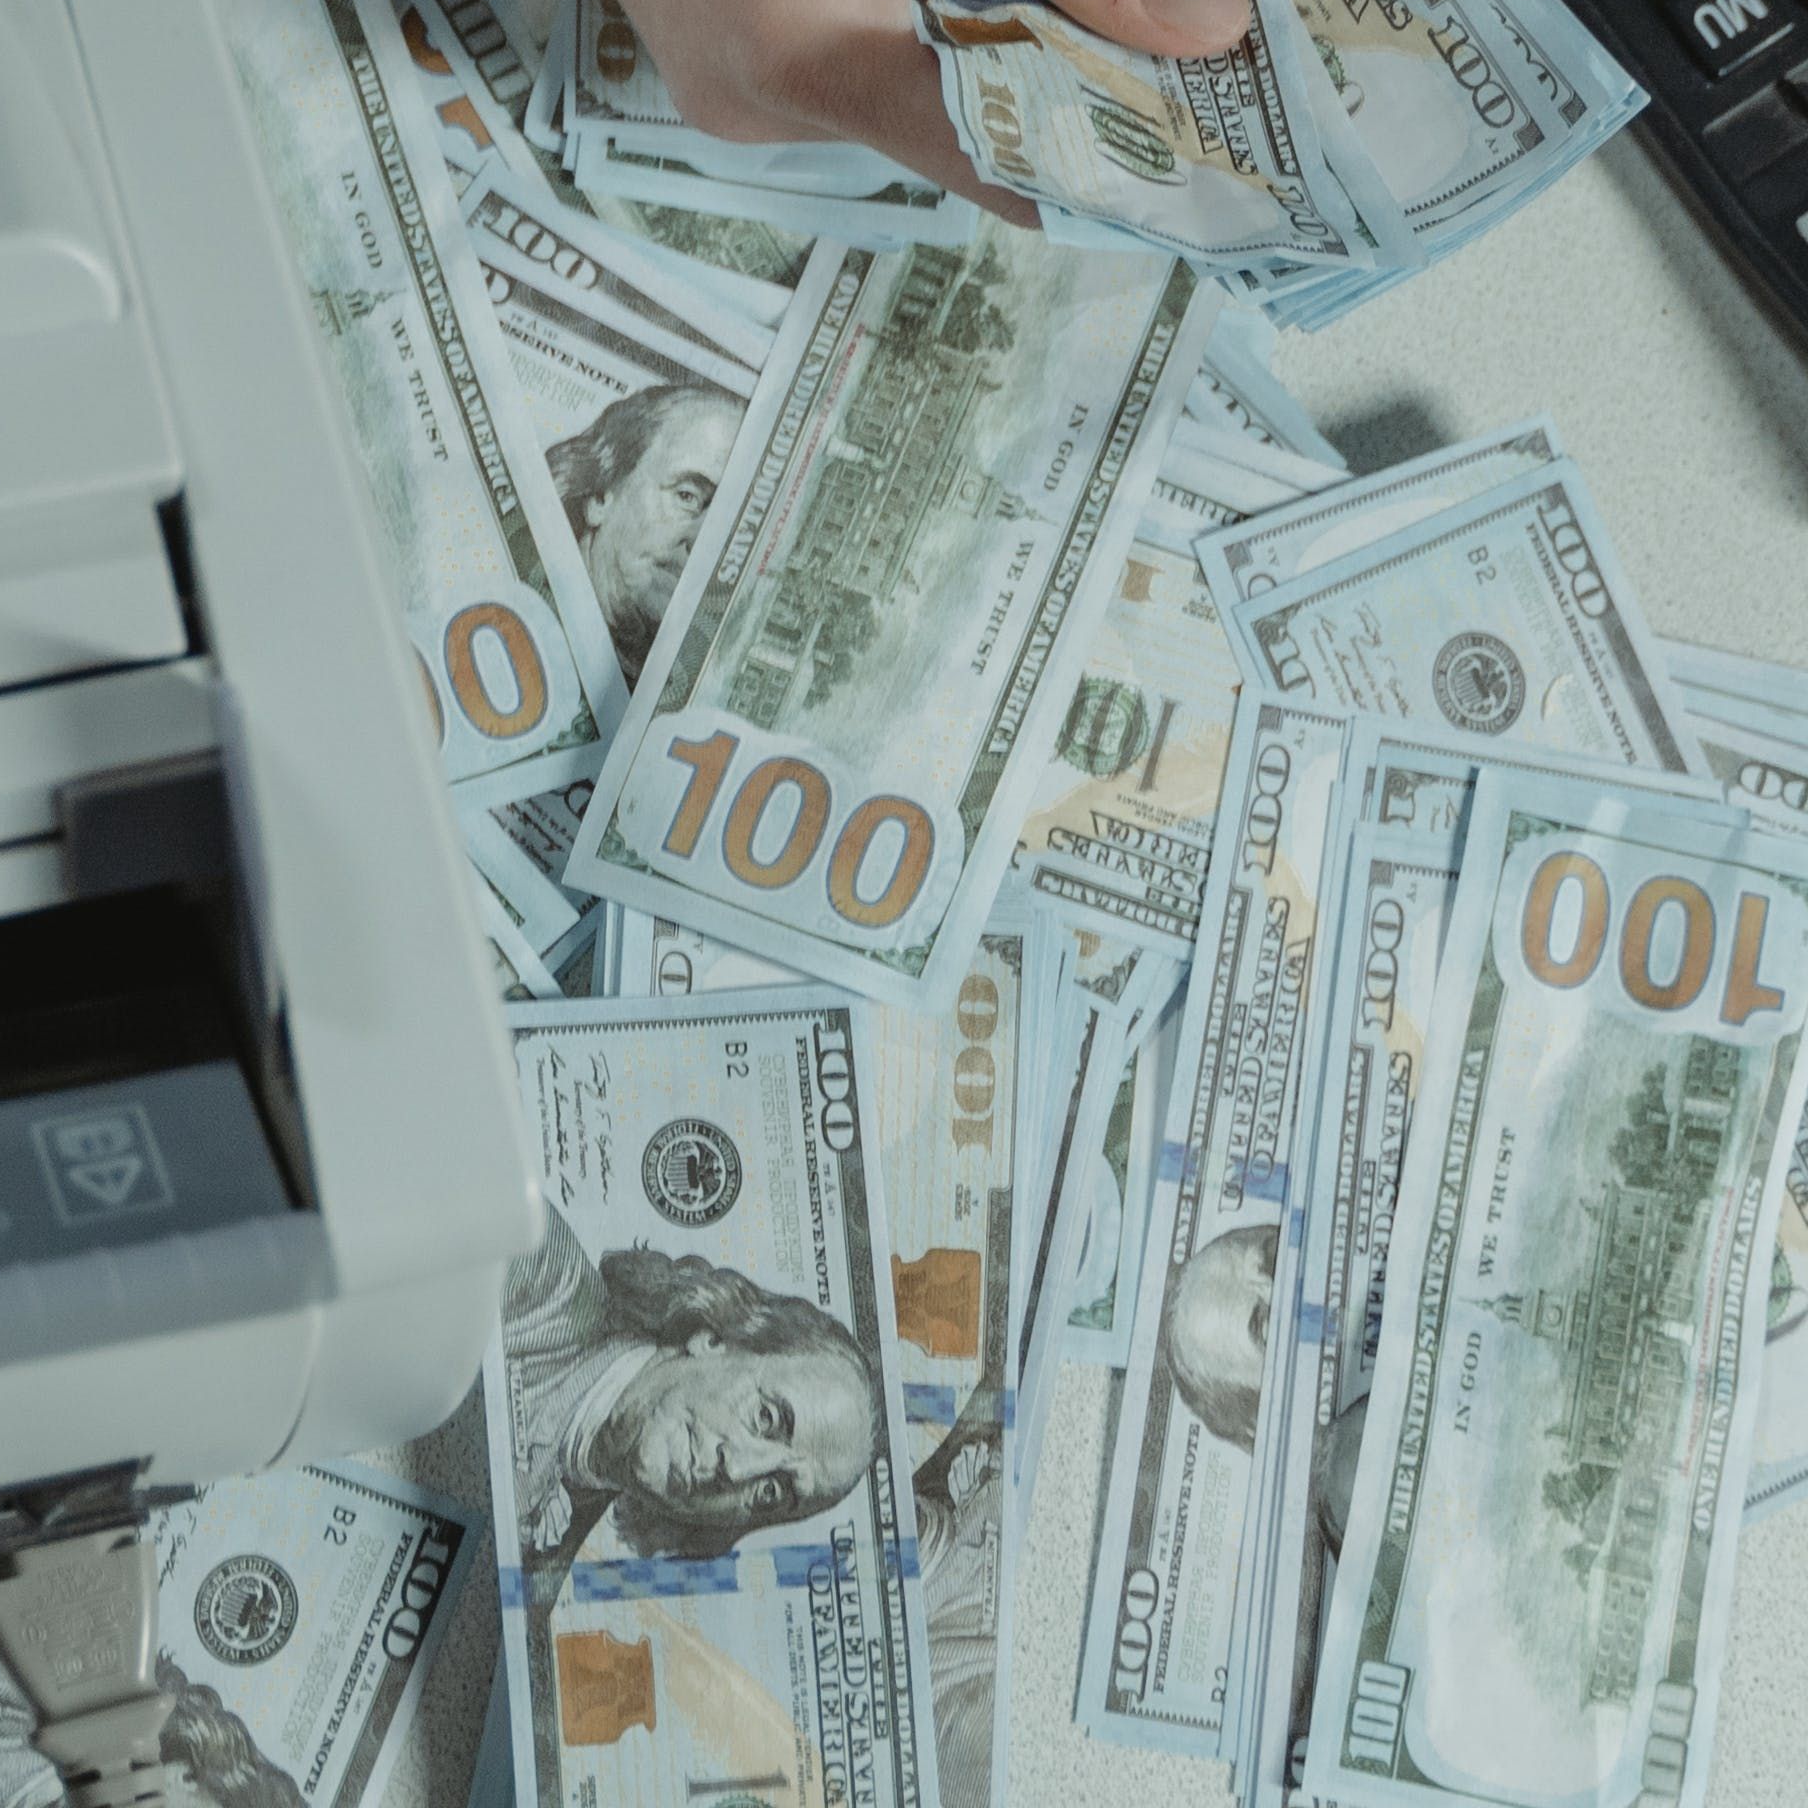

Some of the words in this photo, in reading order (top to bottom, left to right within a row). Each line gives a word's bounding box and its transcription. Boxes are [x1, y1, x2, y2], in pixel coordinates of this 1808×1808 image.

[1429, 17, 1515, 128] 100
[341, 170, 363, 206] IN
[348, 213, 384, 270] GOD
[349, 51, 385, 112] THE
[407, 227, 461, 342] STATES
[459, 384, 519, 518] AMERICA
[483, 197, 602, 293] 100
[390, 318, 415, 362] WE
[401, 373, 450, 462] TRUST
[1043, 440, 1076, 492] GOD
[1069, 404, 1090, 431] IN
[1007, 539, 1034, 583] WE
[1468, 546, 1497, 585] B2
[1538, 496, 1609, 621] 100
[970, 591, 1011, 677] TRUST
[1526, 522, 1568, 614] FEDERAL
[1563, 612, 1611, 712] RESERVE
[1605, 713, 1638, 767] NOTE
[662, 730, 935, 928] 100
[1243, 745, 1291, 876] 100
[1364, 899, 1404, 1031] 100
[1521, 850, 1785, 1026] 100
[724, 1040, 748, 1079] B2
[758, 1054, 777, 1145] SOUVENIR
[795, 1036, 814, 1135] FEDERAL
[813, 1022, 854, 1151] 100
[951, 974, 999, 1154] 100
[766, 1158, 787, 1274] PRODUCTION
[804, 1140, 823, 1243] RESERVE
[1487, 1127, 1515, 1223] TRUST
[813, 1246, 829, 1306] NOTE
[1479, 1235, 1496, 1280] WE
[1460, 1331, 1483, 1391] GOD
[1180, 1423, 1202, 1483] NOTE
[1454, 1398, 1472, 1434] IN
[323, 1505, 355, 1547] B2
[1164, 1486, 1195, 1589] RESERVE
[371, 1530, 413, 1629] FEDERAL
[383, 1538, 450, 1664] 100
[334, 1626, 378, 1726] RESERVE
[1109, 1567, 1164, 1700] 100
[1150, 1592, 1180, 1693] FEDERAL
[304, 1726, 343, 1796] NOTE
[1344, 1663, 1406, 1766] 100
